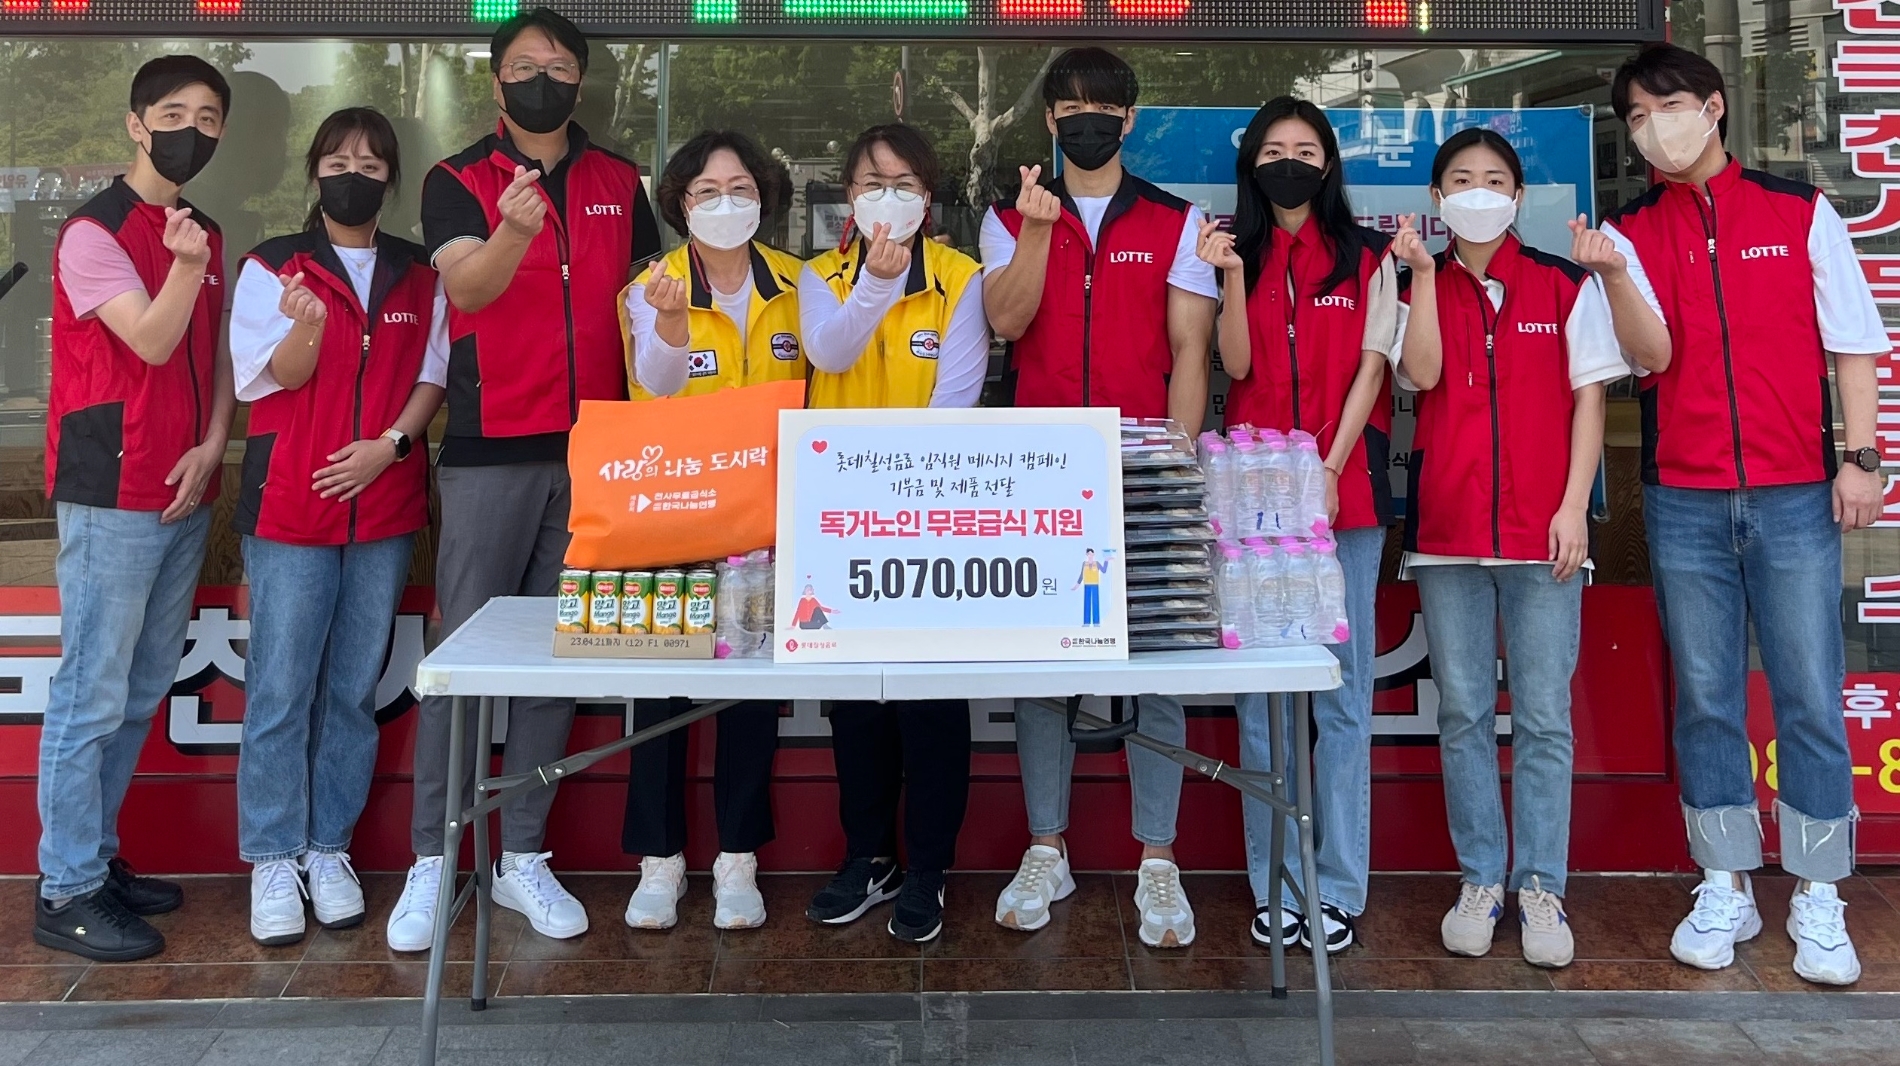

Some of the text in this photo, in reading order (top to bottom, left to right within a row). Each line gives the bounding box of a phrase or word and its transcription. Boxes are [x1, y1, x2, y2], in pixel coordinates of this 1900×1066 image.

[585, 204, 623, 216] LOTTE
[1110, 251, 1153, 264] LOTTE
[1741, 245, 1789, 260] LOTTE
[1314, 295, 1355, 311] LOTTE
[383, 312, 419, 326] LOTTE
[1517, 321, 1558, 335] LOTTE
[599, 446, 768, 481] 사랑의 나눔 도시락
[836, 450, 1067, 472] 롯데칠성음료 임직원 메시지 캠페인
[890, 477, 1016, 498] 기부금 및 제품 전달
[819, 508, 1084, 538] 독거노인 무료급식 지원
[848, 557, 1058, 602] 5,070,000 원
[594, 599, 615, 610] 망고
[657, 600, 677, 610] 망고
[690, 600, 710, 611] 망고
[625, 638, 644, 648] (12)
